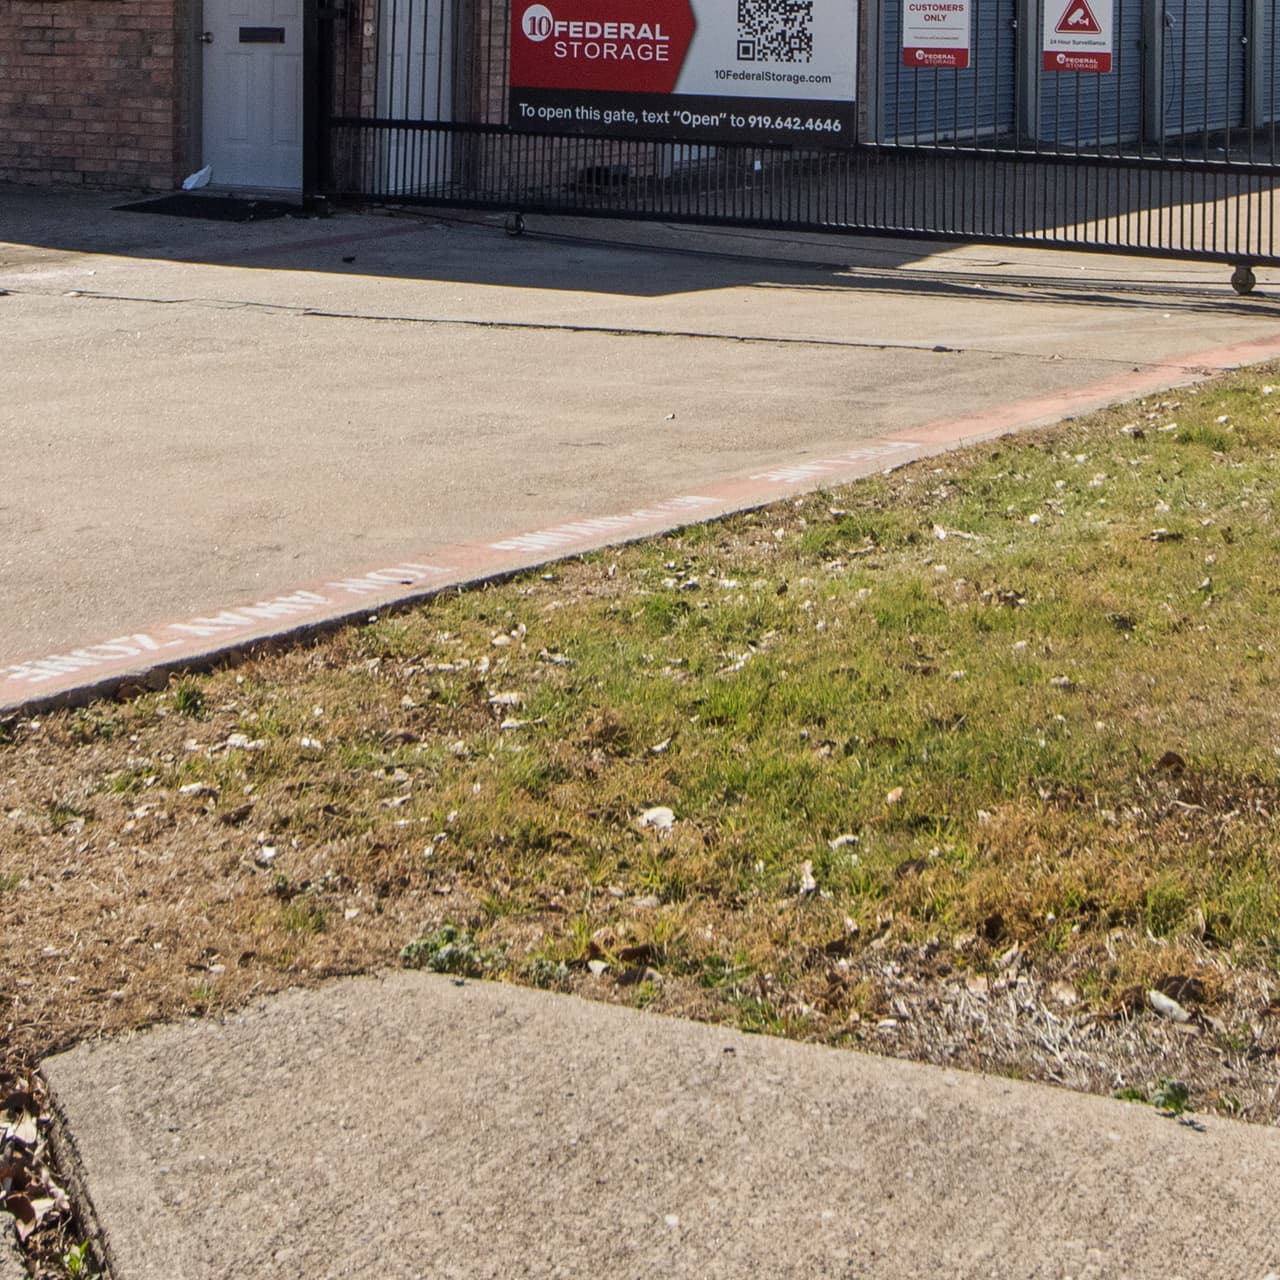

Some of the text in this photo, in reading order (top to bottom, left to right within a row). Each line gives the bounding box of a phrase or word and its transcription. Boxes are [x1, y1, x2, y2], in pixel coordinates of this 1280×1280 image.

[909, 4, 964, 12] CUSTOMERS
[924, 14, 947, 22] ONLY
[527, 16, 670, 41] 10 FEDERAL
[554, 41, 669, 61] STORAGE
[714, 70, 832, 85] 10FederalStorage.com
[519, 103, 535, 117] To
[538, 106, 571, 120] open
[575, 106, 601, 120] this
[604, 108, 639, 124] gate,
[642, 110, 670, 124] text
[730, 114, 746, 128] to
[748, 115, 842, 132] 919.642.4646
